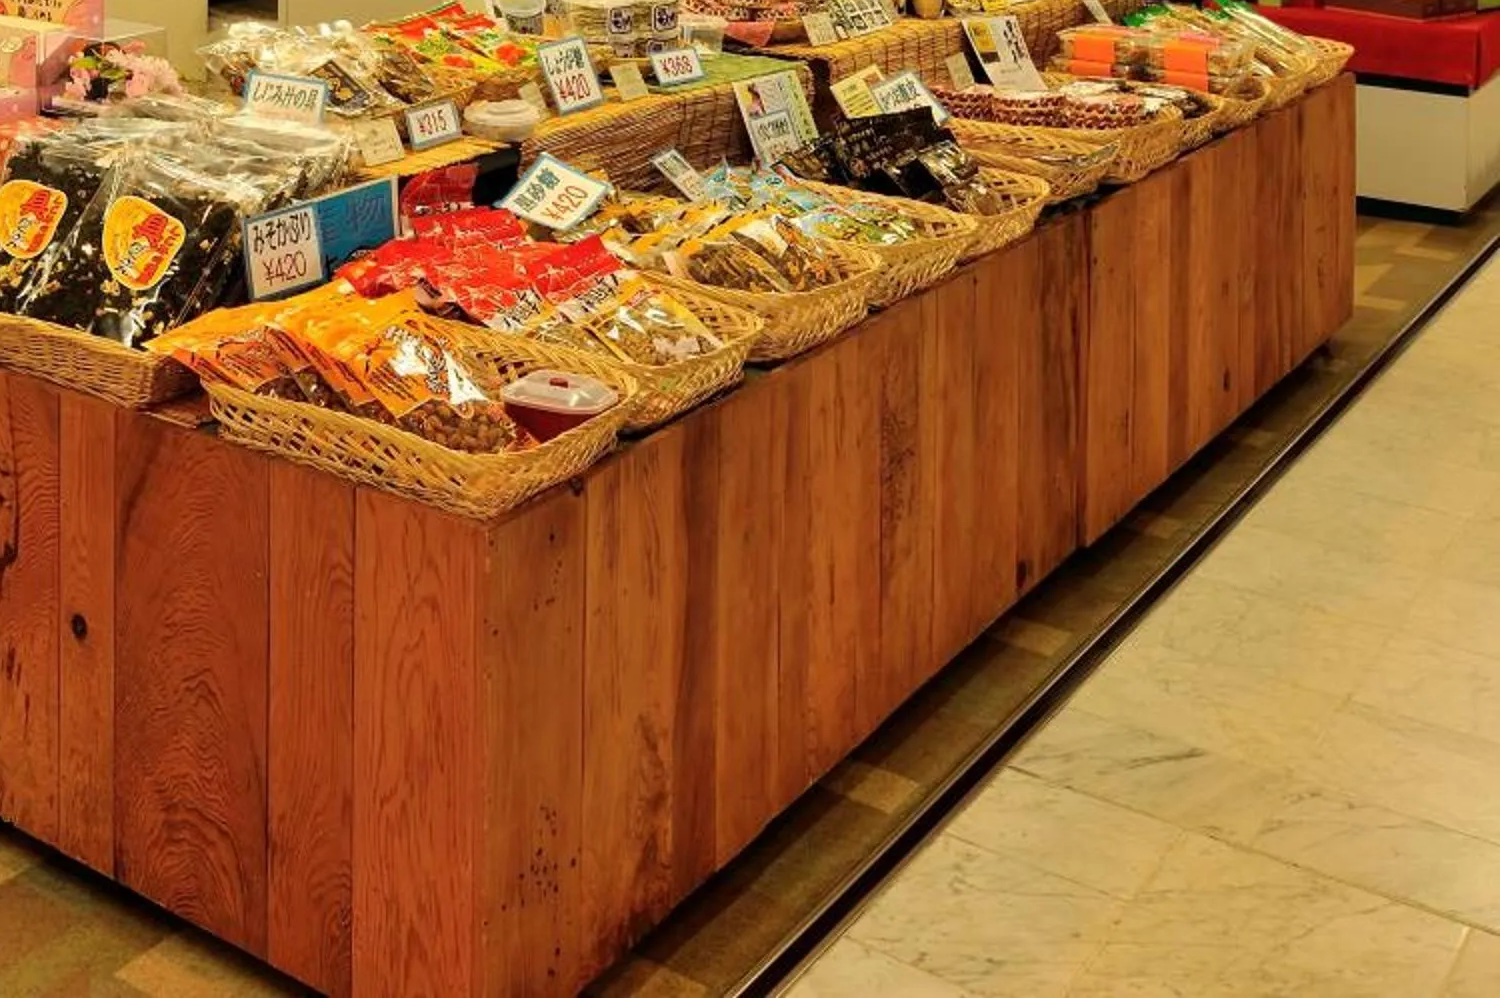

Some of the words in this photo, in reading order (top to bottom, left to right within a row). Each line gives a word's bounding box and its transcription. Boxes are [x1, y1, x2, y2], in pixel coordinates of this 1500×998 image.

[659, 56, 693, 79] ¥368
[554, 73, 591, 103] ¥420
[417, 108, 449, 137] ¥315
[540, 184, 589, 222] ¥420
[262, 250, 308, 287] ¥420
